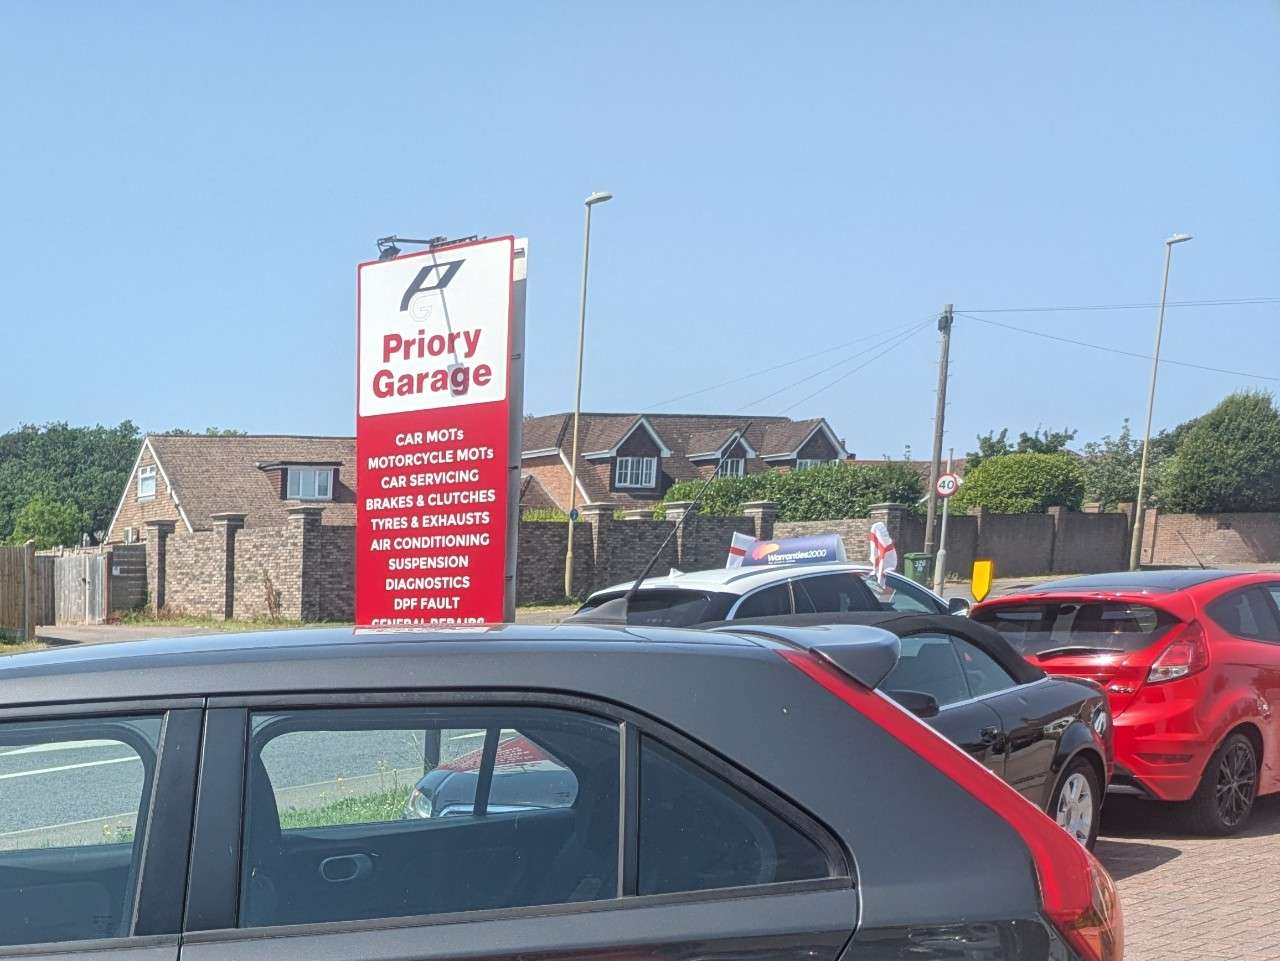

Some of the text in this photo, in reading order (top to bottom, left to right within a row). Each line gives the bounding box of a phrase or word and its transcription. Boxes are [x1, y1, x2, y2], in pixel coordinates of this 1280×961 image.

[383, 329, 482, 363] Priory
[373, 364, 492, 399] Garage
[395, 428, 464, 447] CAR MOTs
[368, 447, 494, 470] MOTORCYCLE MOTs
[381, 469, 479, 489] CAR SERVICING
[939, 480, 955, 490] 40
[366, 489, 496, 511] BRAKES & CLUTCHES
[371, 511, 490, 530] TYRES & EXHAUSTS
[370, 533, 490, 551] AIR CONDITIONING
[388, 555, 469, 570] SUSPENSION
[385, 576, 470, 591] DIAGNOSTICS
[394, 597, 460, 610] DPF FAULT
